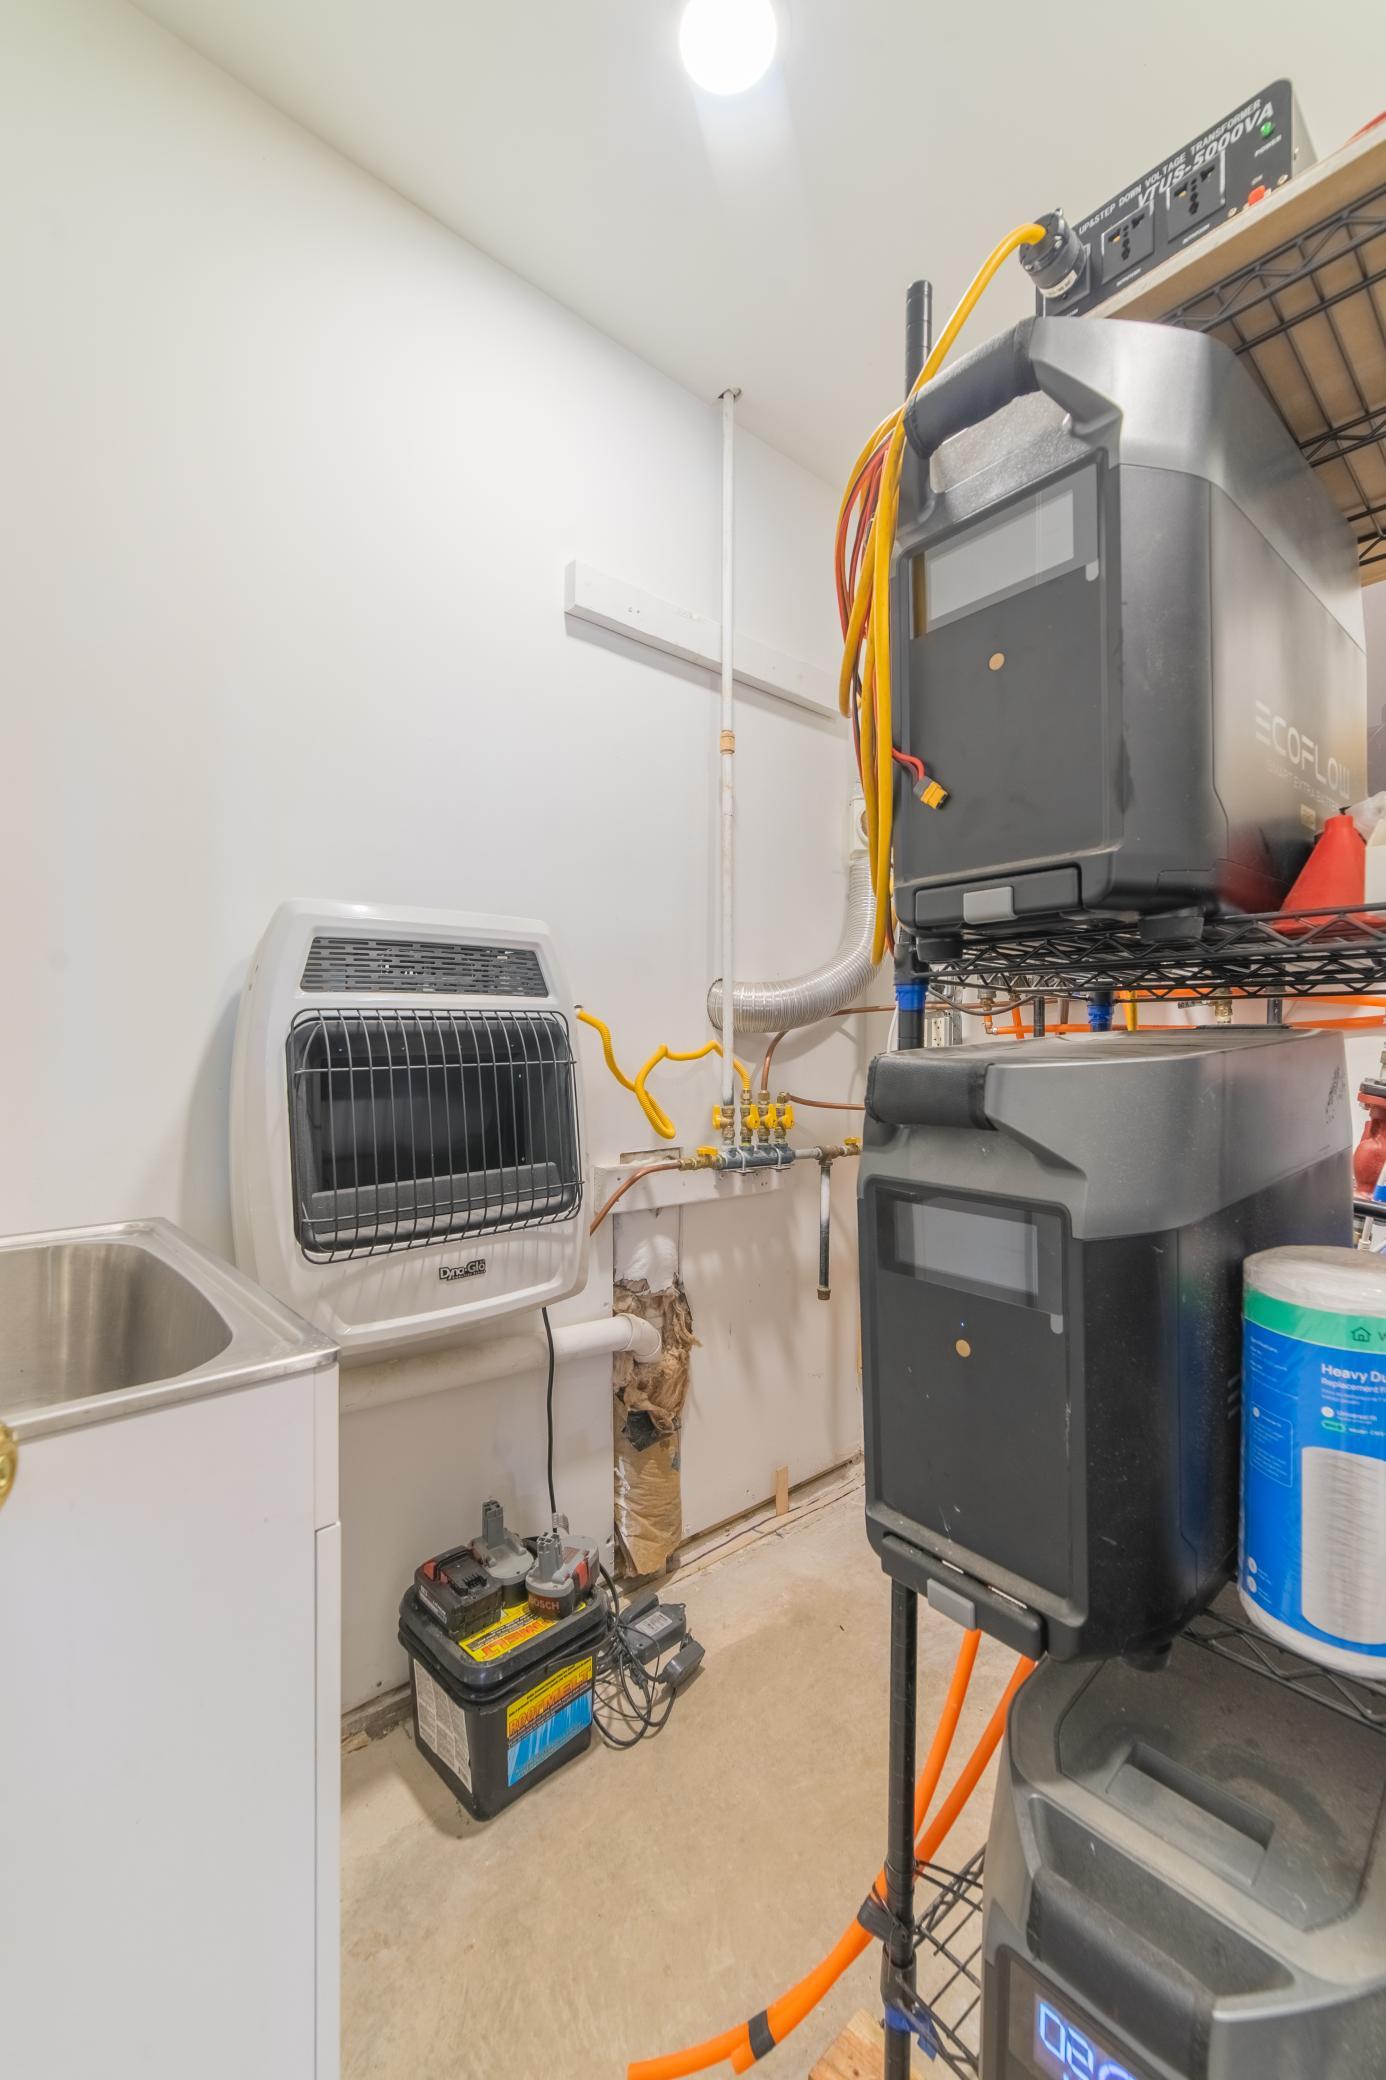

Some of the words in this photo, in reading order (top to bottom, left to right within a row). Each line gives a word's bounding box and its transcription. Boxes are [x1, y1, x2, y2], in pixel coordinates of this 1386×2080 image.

[1118, 183, 1142, 207] DOWN
[1145, 152, 1187, 188] VOLTAGE
[1190, 98, 1262, 156] TRANSFORMER
[1255, 699, 1351, 800] ECOFLOW
[1321, 1362, 1368, 1384] Heavy
